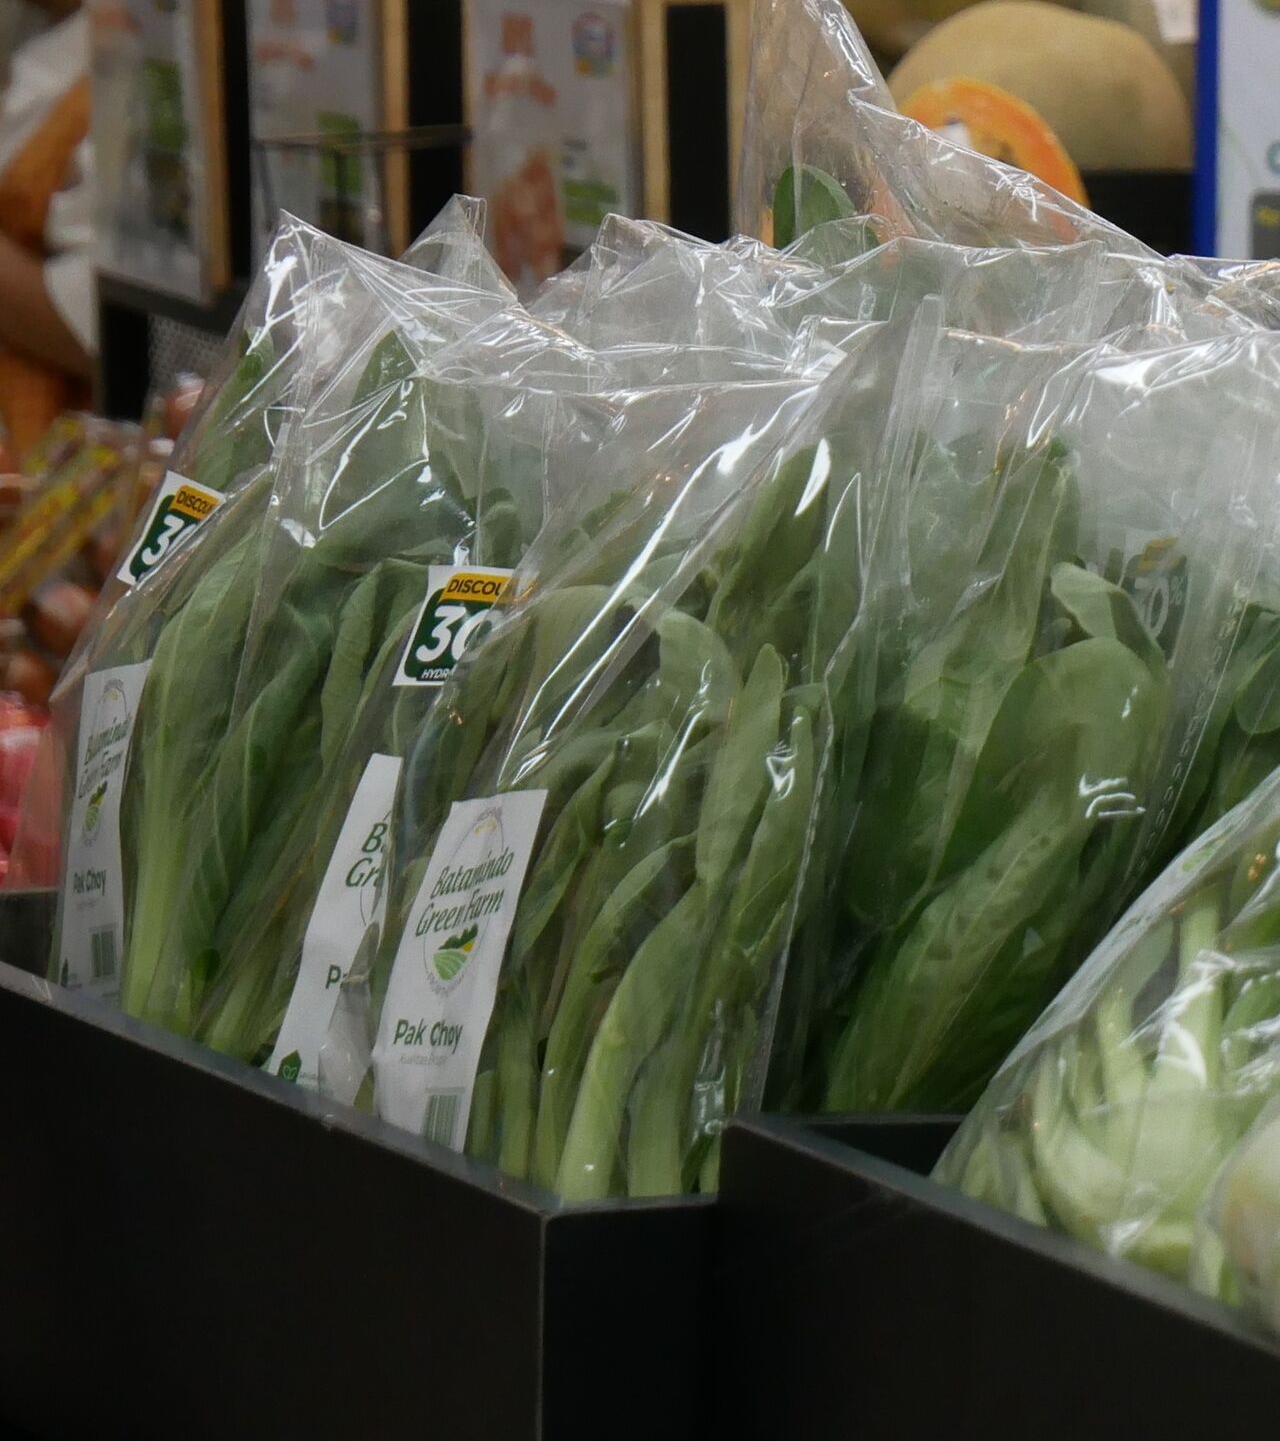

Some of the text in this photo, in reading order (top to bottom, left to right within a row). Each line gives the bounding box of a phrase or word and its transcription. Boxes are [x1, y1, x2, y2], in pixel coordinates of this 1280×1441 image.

[430, 846, 514, 900] Batamindo
[415, 888, 505, 937] Green Farm
[393, 1018, 463, 1055] Pak Choy
